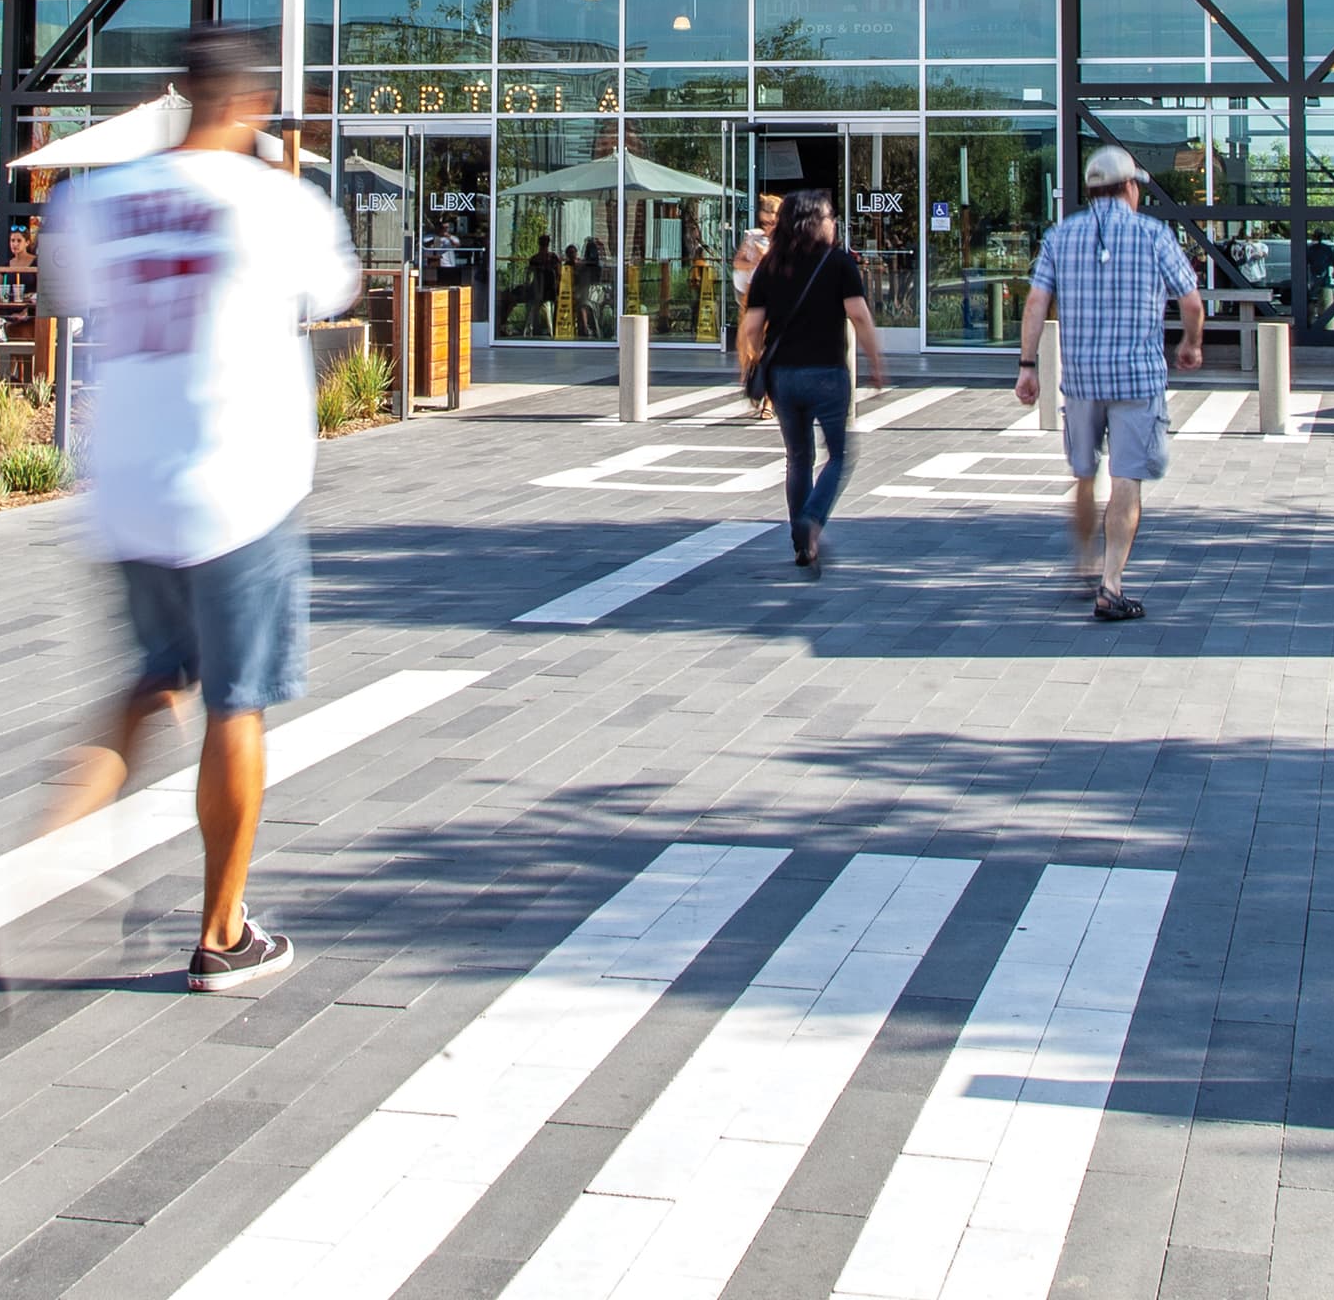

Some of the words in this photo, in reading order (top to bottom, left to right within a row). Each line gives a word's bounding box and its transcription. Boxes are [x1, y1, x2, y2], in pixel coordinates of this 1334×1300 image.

[355, 193, 398, 211] LBX
[430, 192, 476, 211] LBX
[857, 193, 904, 213] LBX
